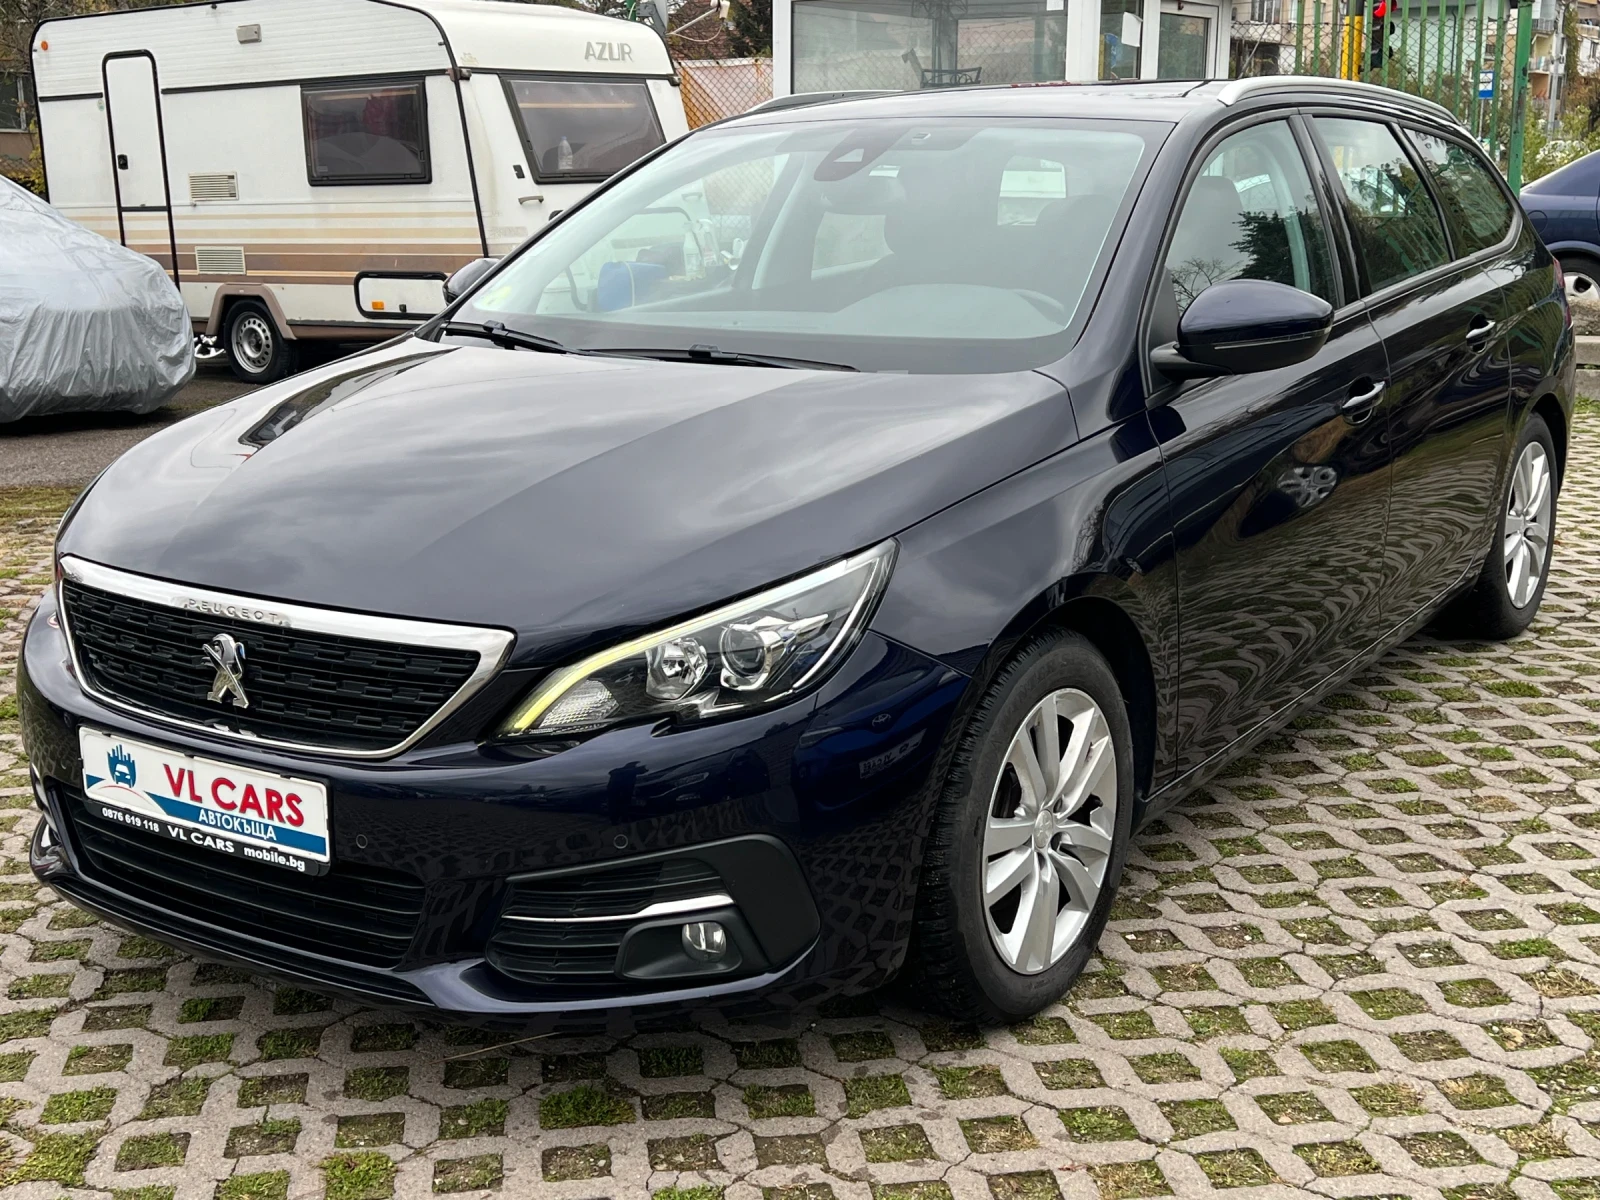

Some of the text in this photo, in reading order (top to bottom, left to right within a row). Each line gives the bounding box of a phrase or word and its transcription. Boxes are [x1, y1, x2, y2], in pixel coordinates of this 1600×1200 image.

[584, 41, 633, 62] AZUR
[187, 598, 278, 622] PEUGEOT
[163, 763, 304, 827] VL CARS
[102, 807, 305, 872] 0876 619 118 VL CARS mobile.bg
[199, 809, 277, 841] АВТОКЪЩА
